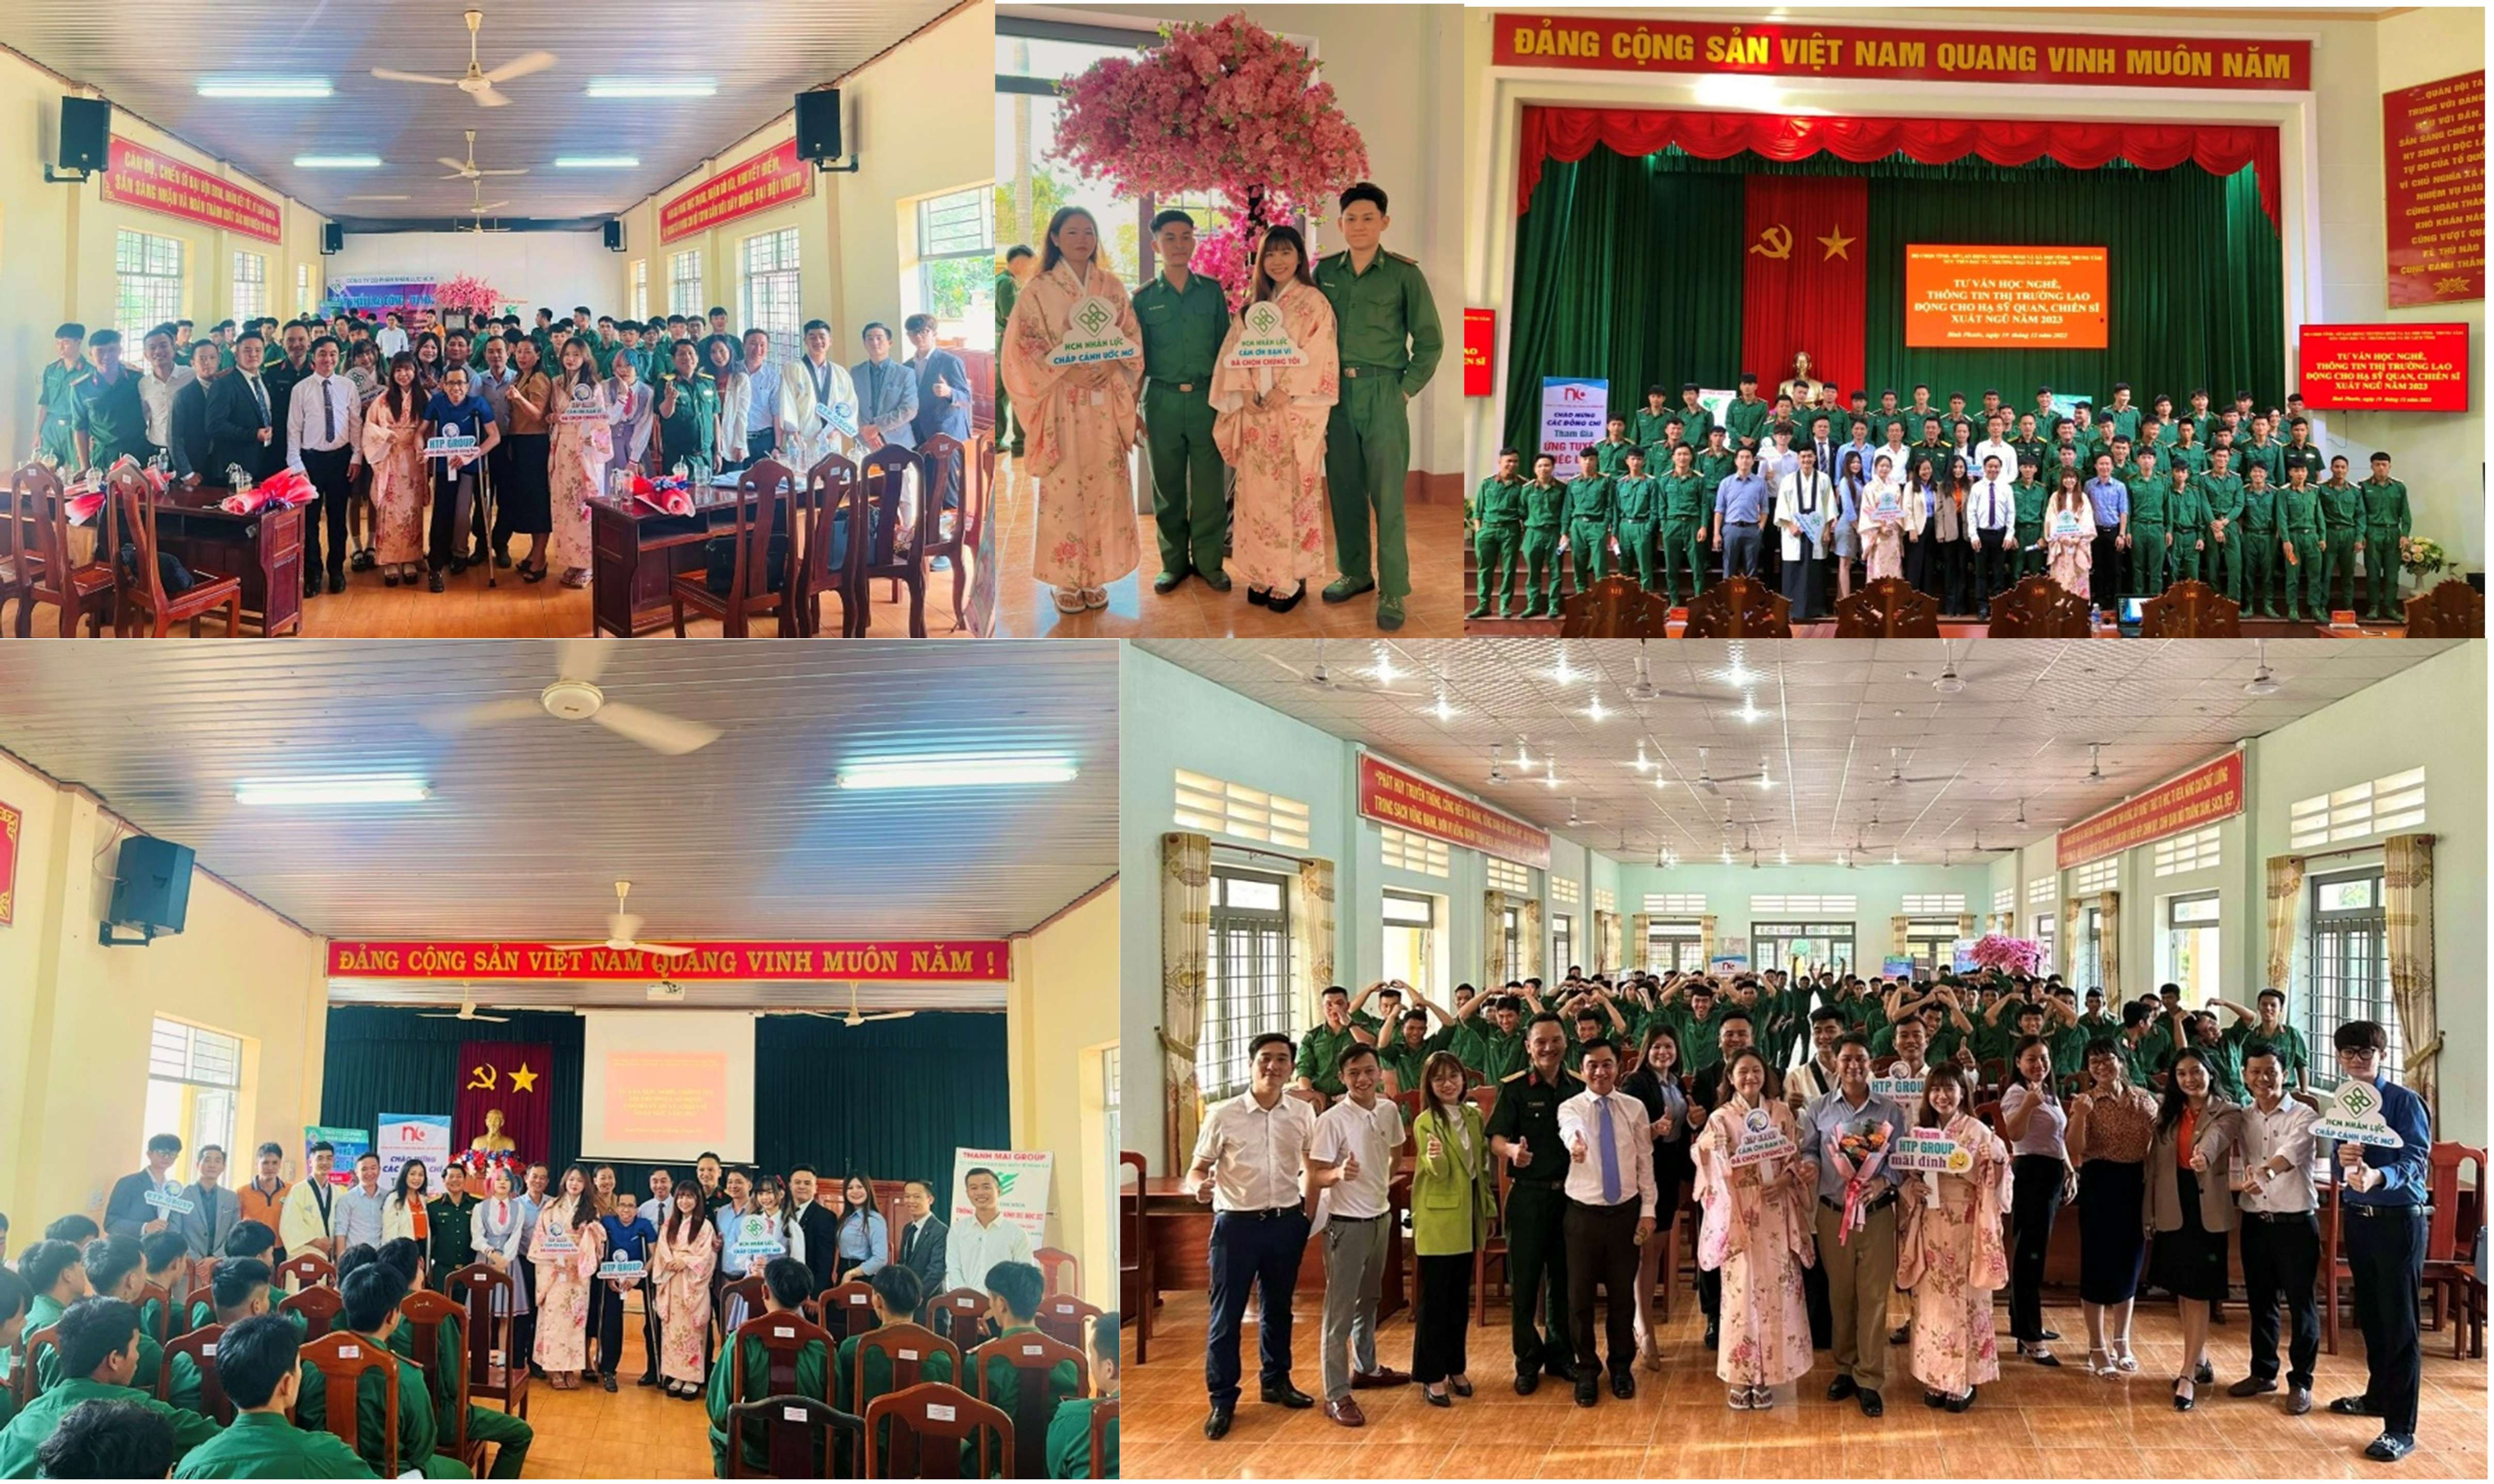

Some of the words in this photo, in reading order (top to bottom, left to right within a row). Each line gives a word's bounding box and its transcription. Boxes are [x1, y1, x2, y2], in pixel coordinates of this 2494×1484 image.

[1514, 19, 1600, 57] ĐẢNG
[1612, 27, 1694, 66] CỘNG
[1706, 27, 1768, 64] SẢN
[1780, 32, 1842, 70] VIỆT
[1856, 40, 1925, 68] NAM
[1937, 42, 2036, 72] QUANG
[2048, 46, 2116, 74] VINH
[2127, 44, 2212, 76] MUÔN
[2222, 46, 2290, 79] NĂM
[2472, 79, 2483, 88] TA
[2408, 104, 2437, 117] TRUNG
[2404, 152, 2415, 160] HY
[2418, 147, 2439, 158] SINH
[2418, 163, 2429, 171] DO
[1973, 279, 1996, 289] VẤN
[1999, 280, 2023, 290] HỌC
[1927, 289, 1967, 299] THÔNG
[1971, 291, 1990, 299] TIN
[1993, 292, 2013, 301] THỊ
[2016, 289, 2064, 300] TRƯỜNG
[2067, 292, 2090, 300] LAO
[1914, 302, 1947, 313] ĐỘNG
[1950, 303, 1975, 312] CHO
[1978, 303, 1993, 314] HẠ
[2014, 304, 2048, 314] QUAN,
[2051, 302, 2086, 313] CHIẾN
[2089, 303, 2099, 312] SĨ
[1952, 314, 1982, 323] XUẤT
[1986, 314, 2009, 323] NGŨ
[2013, 314, 2038, 324] NĂM
[2041, 315, 2063, 324] 2023
[1065, 342, 1083, 350] HCM
[1085, 338, 1107, 348] NHÂN
[1110, 336, 1123, 347] LỰC
[1079, 352, 1101, 362] CÁNH
[1103, 349, 1119, 359] ƯỚC
[429, 439, 445, 448] HTP
[447, 437, 475, 448] GROUP
[339, 944, 399, 971] ĐẢNG
[408, 945, 466, 975] CỘNG
[473, 944, 518, 971] SẢN
[527, 949, 583, 976] VIỆT
[591, 951, 643, 971] NAM
[651, 951, 736, 977] QUANG
[747, 951, 812, 972] VINH
[823, 945, 898, 972] MUÔN
[911, 945, 974, 972] NĂM
[987, 951, 995, 975] !
[1872, 1080, 1892, 1092] HTP
[1895, 1080, 1925, 1092] GROU
[2345, 1120, 2368, 1130] NHÂN
[2370, 1122, 2385, 1133] LỰC
[1913, 1130, 1940, 1139] Team
[2338, 1130, 2359, 1139] CÁNH
[1899, 1140, 1918, 1152] HTP
[1921, 1141, 1955, 1154] GROUP
[603, 1264, 615, 1272] HTP
[617, 1263, 641, 1271] GROUP
